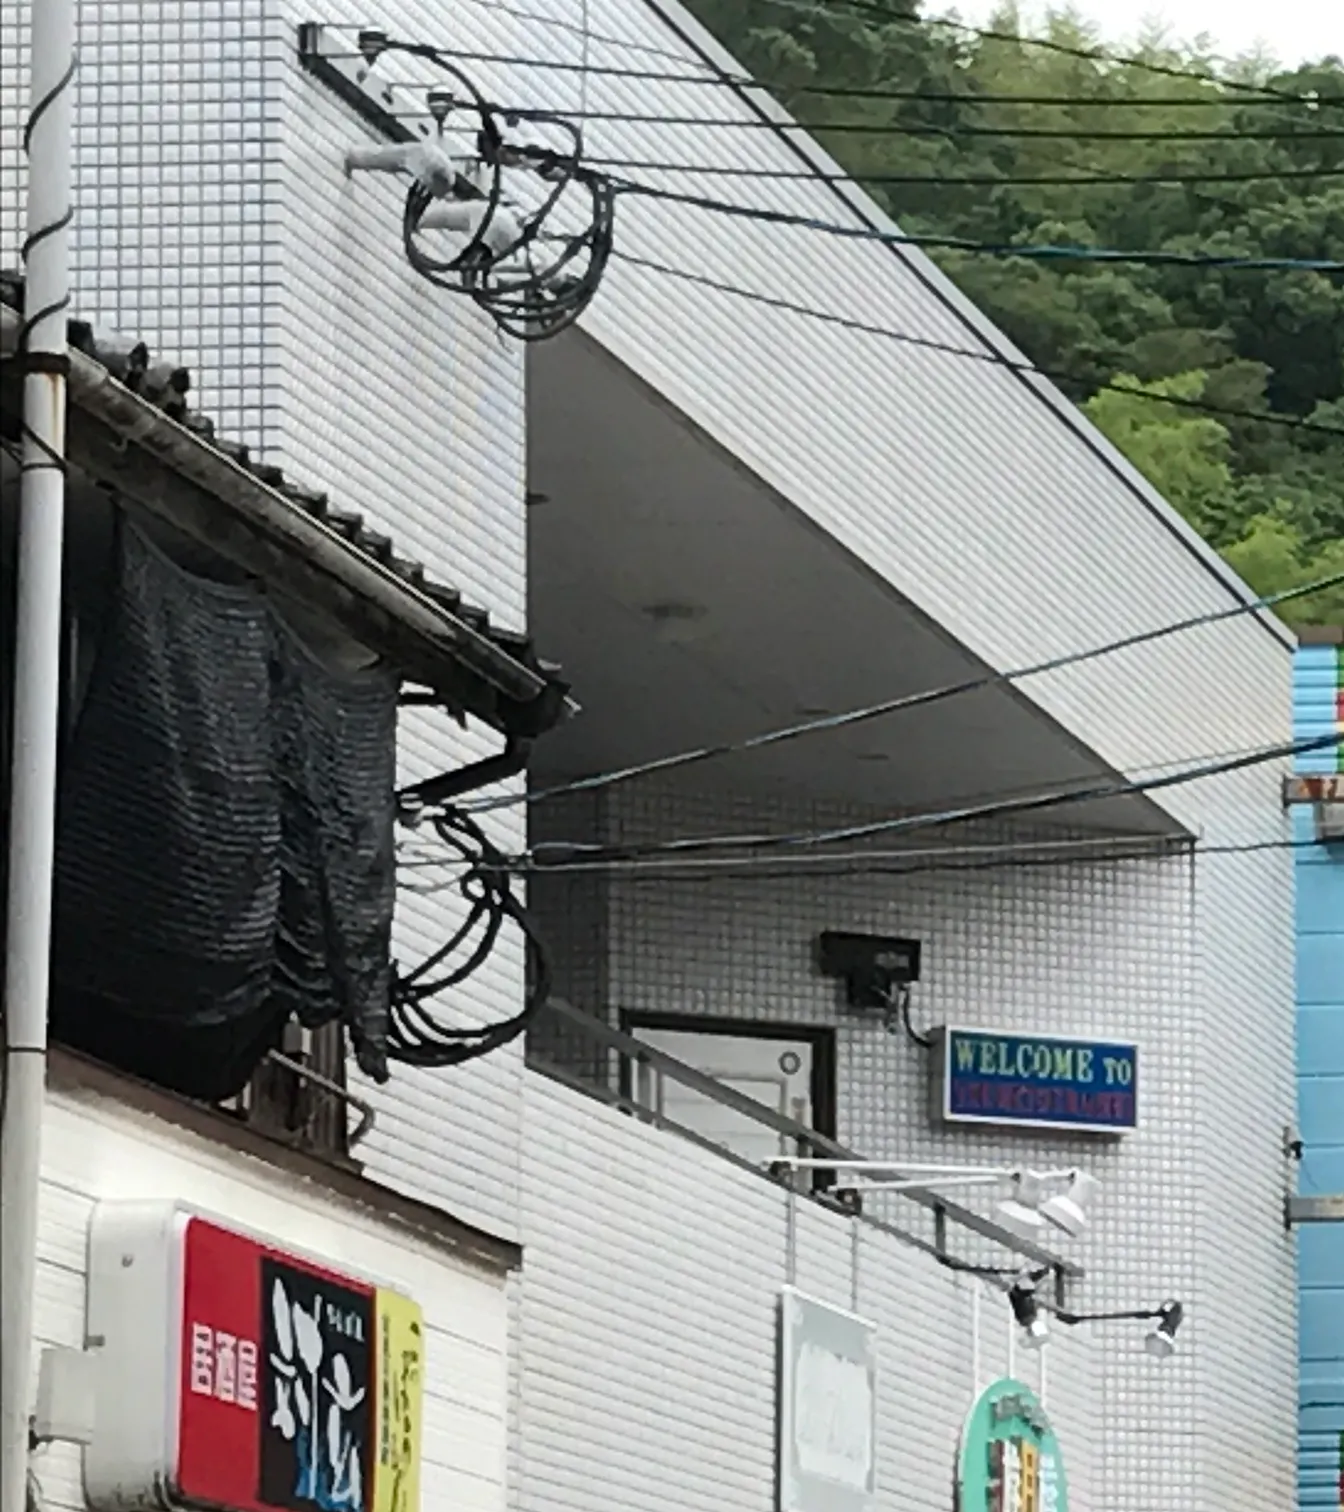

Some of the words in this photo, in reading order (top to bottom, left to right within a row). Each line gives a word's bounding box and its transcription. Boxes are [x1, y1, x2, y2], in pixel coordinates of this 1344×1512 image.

[955, 1039, 1094, 1083] WELCOME
[1102, 1057, 1132, 1086] TO
[191, 1322, 258, 1411] 居酒屋
